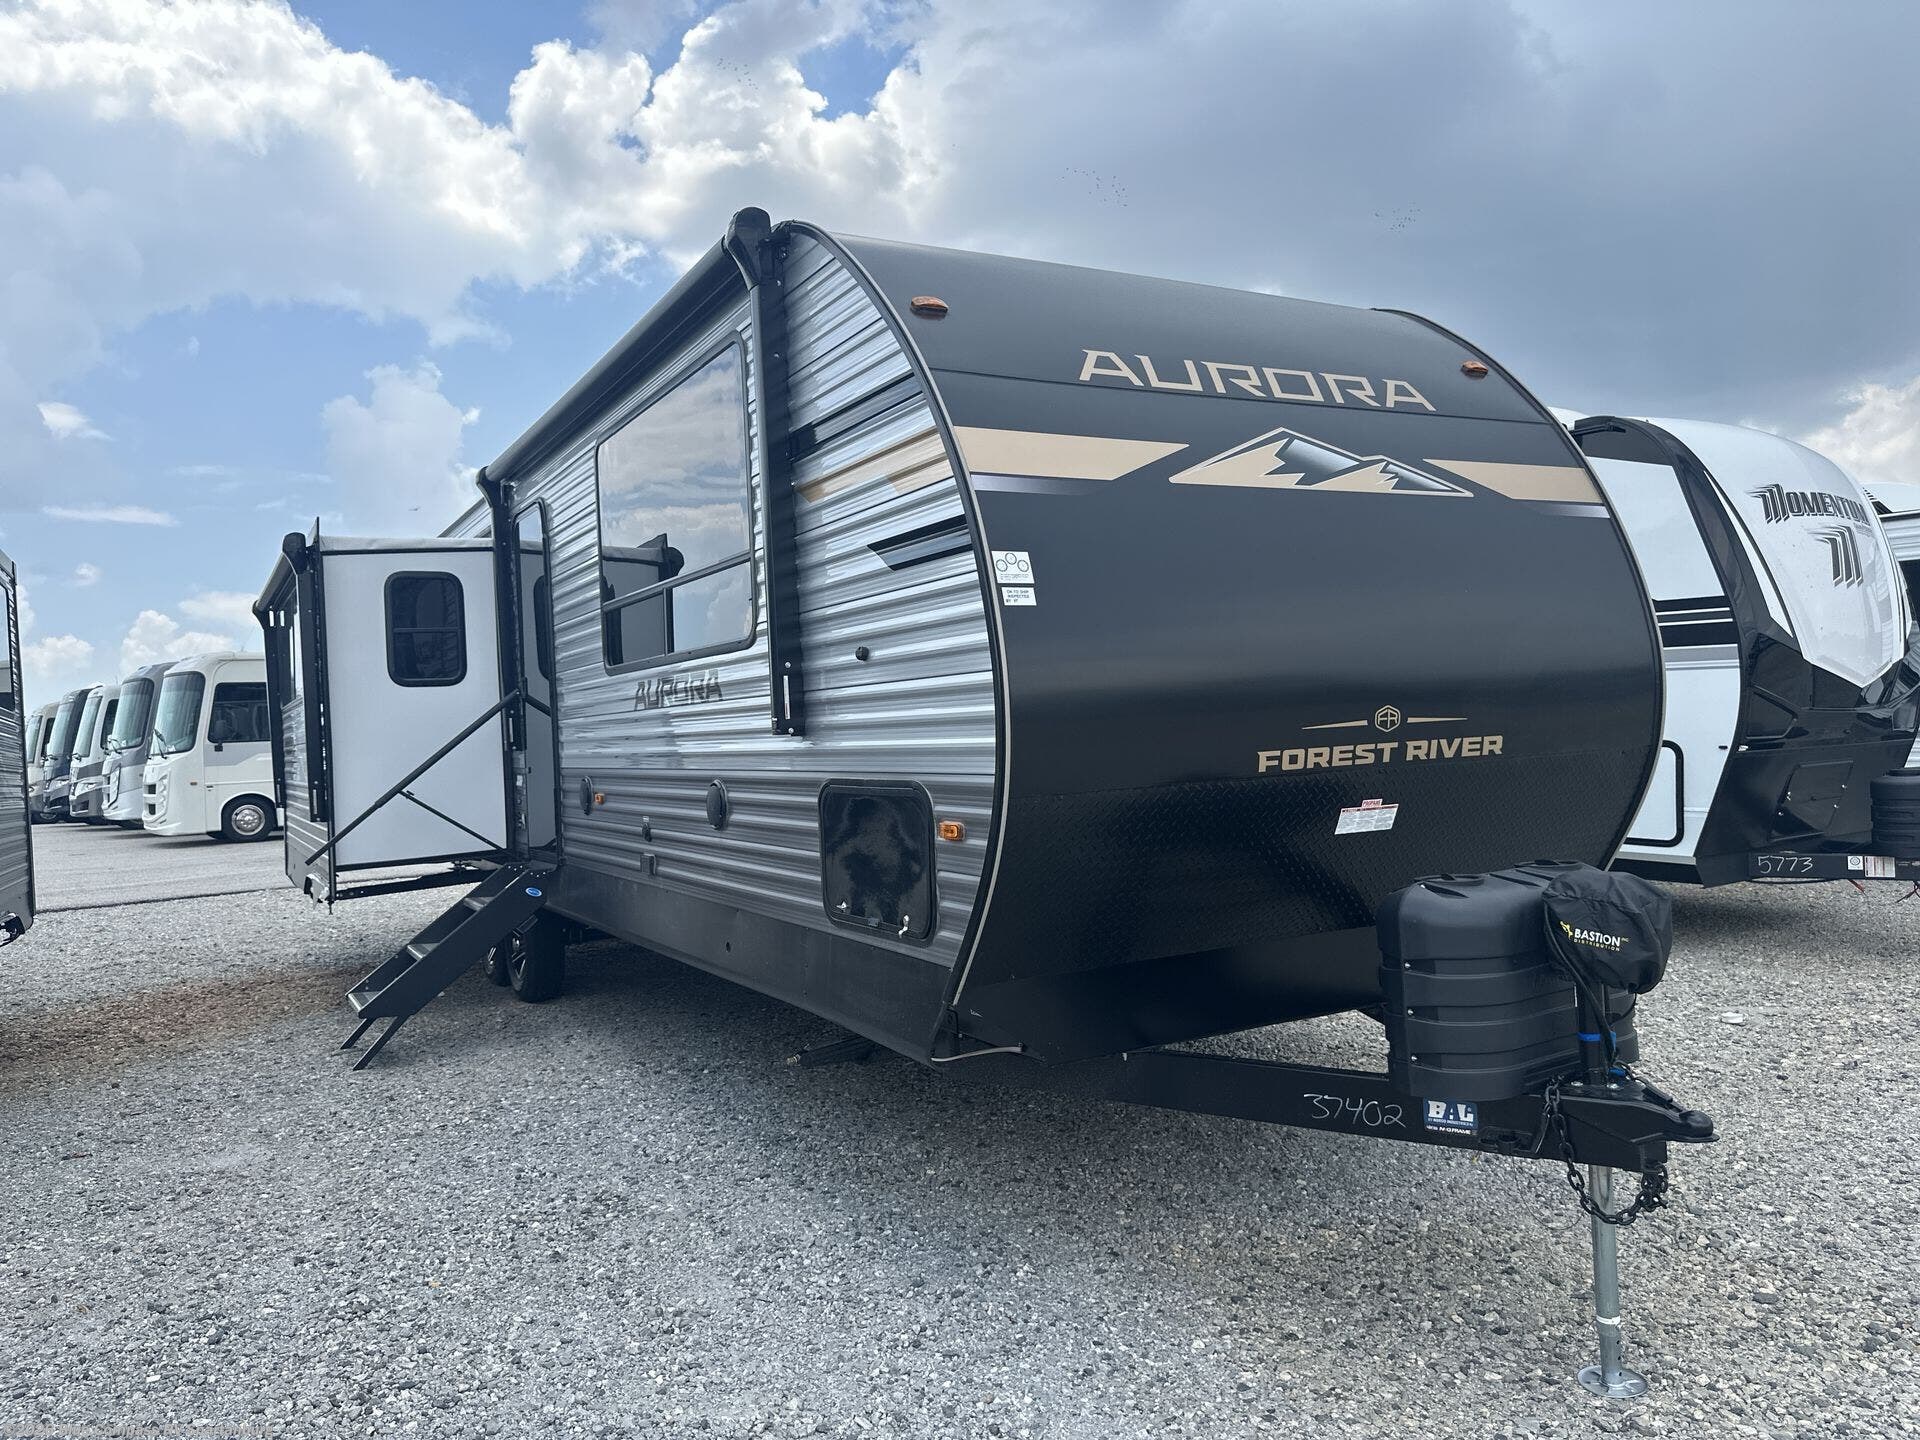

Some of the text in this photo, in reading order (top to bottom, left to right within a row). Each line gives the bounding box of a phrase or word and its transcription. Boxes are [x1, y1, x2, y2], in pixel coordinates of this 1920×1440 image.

[1079, 349, 1437, 412] AURORA
[634, 669, 722, 712] AURORA
[1257, 735, 1504, 773] FOREST RIVER
[1757, 855, 1813, 874] 5773
[1573, 938, 1620, 952] DISTRIBUTION
[1574, 928, 1621, 947] BASTION
[1303, 1094, 1406, 1128] 37402
